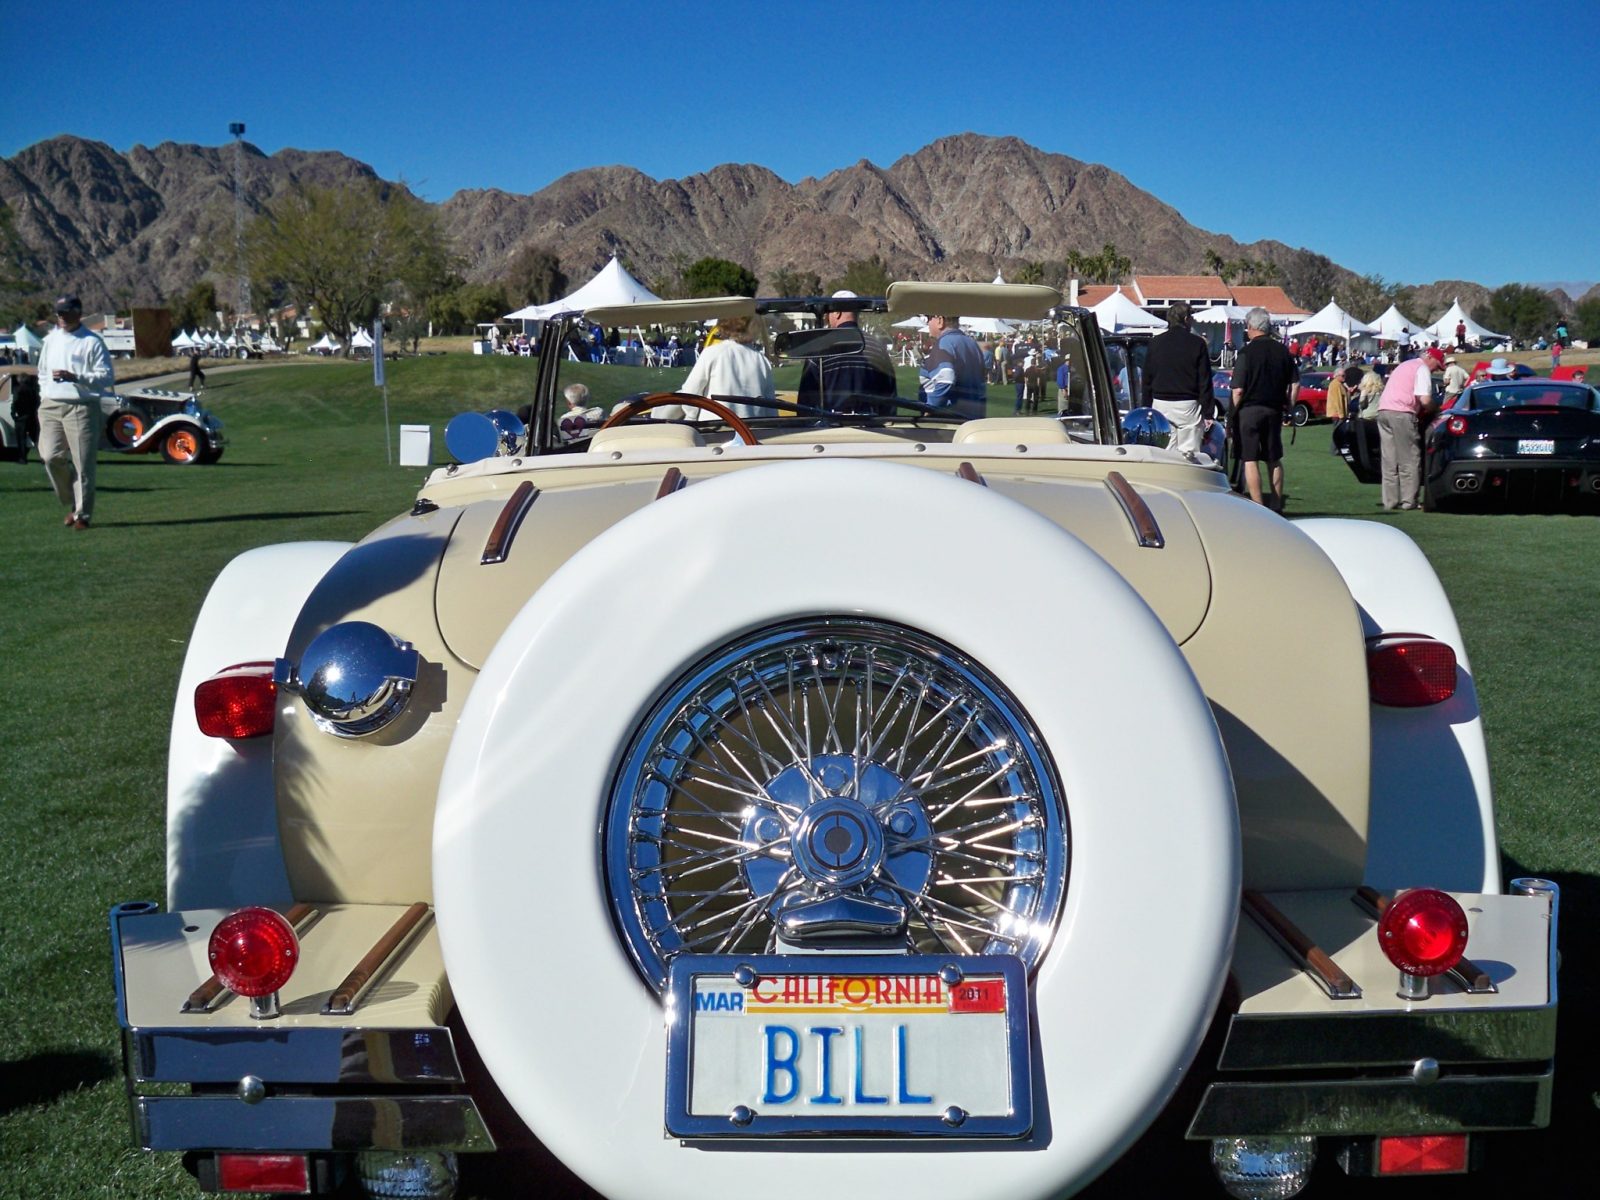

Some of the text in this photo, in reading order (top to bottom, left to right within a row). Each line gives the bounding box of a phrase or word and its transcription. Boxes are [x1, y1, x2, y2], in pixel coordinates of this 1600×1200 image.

[696, 992, 744, 1011] MAR
[752, 976, 942, 1004] CALIFORNIA
[960, 987, 989, 1001] 2011
[762, 1025, 933, 1104] BILL
